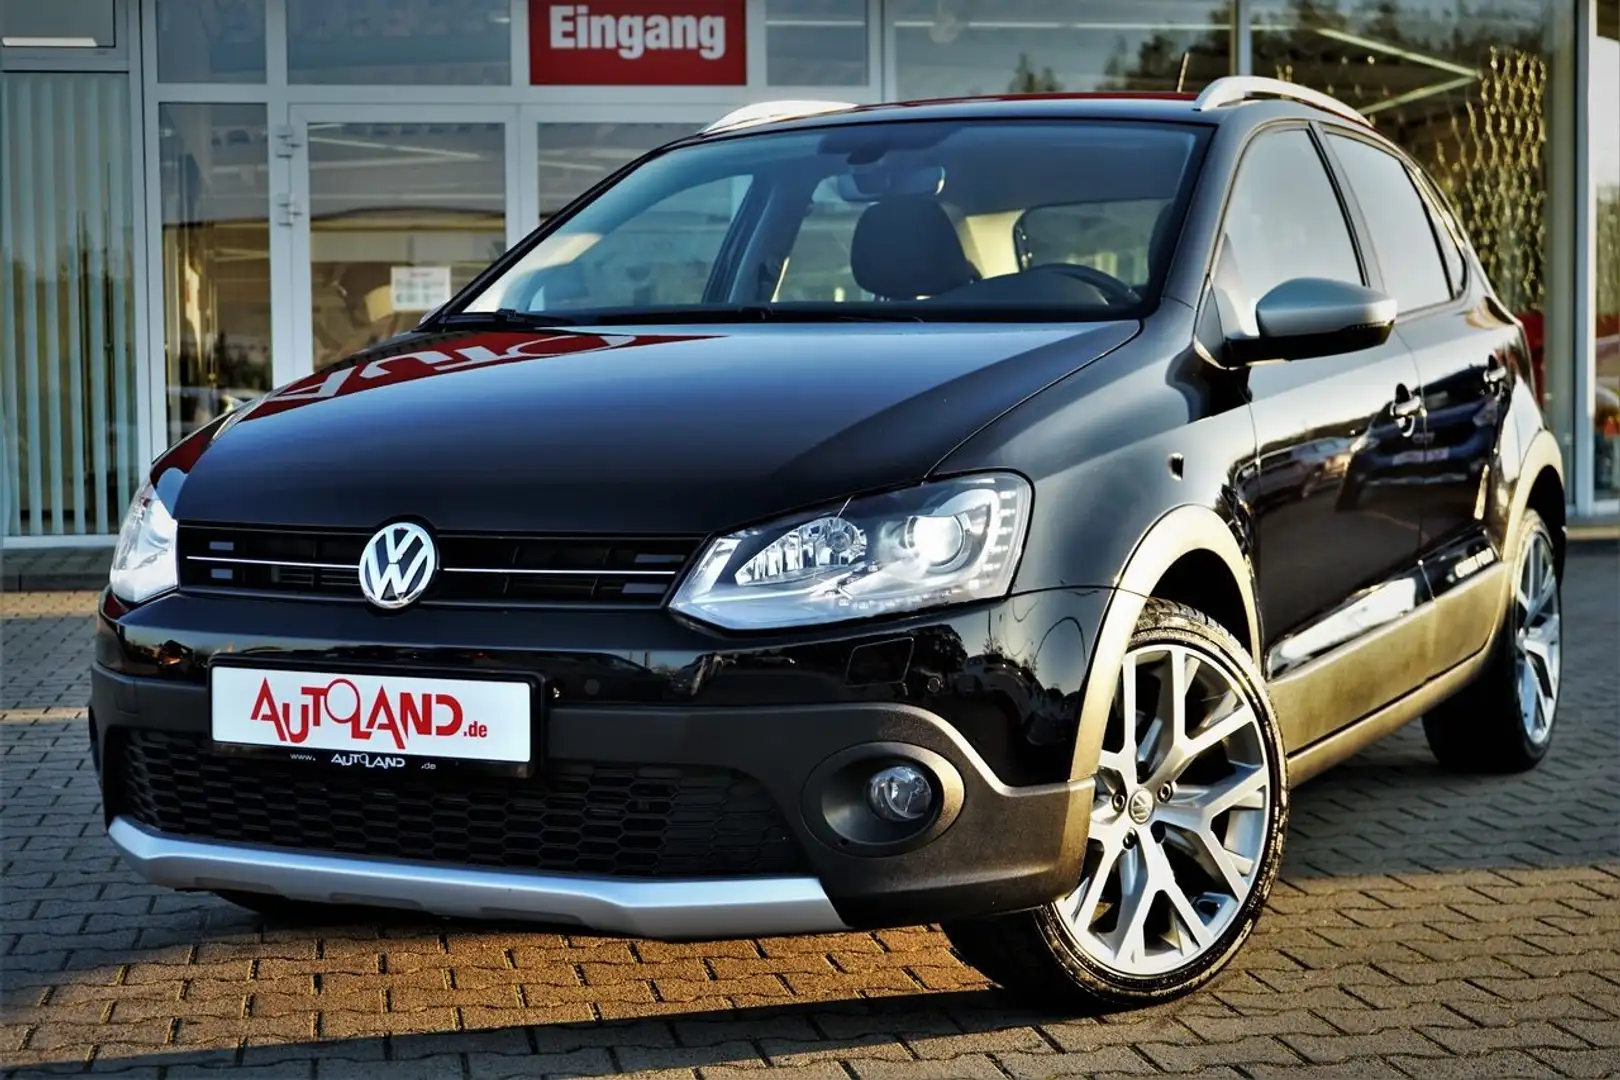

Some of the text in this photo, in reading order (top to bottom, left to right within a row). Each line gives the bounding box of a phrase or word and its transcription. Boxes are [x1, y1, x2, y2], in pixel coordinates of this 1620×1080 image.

[550, 5, 726, 60] Eingang
[361, 524, 433, 606] VW
[331, 753, 406, 770] AUTOLAND
